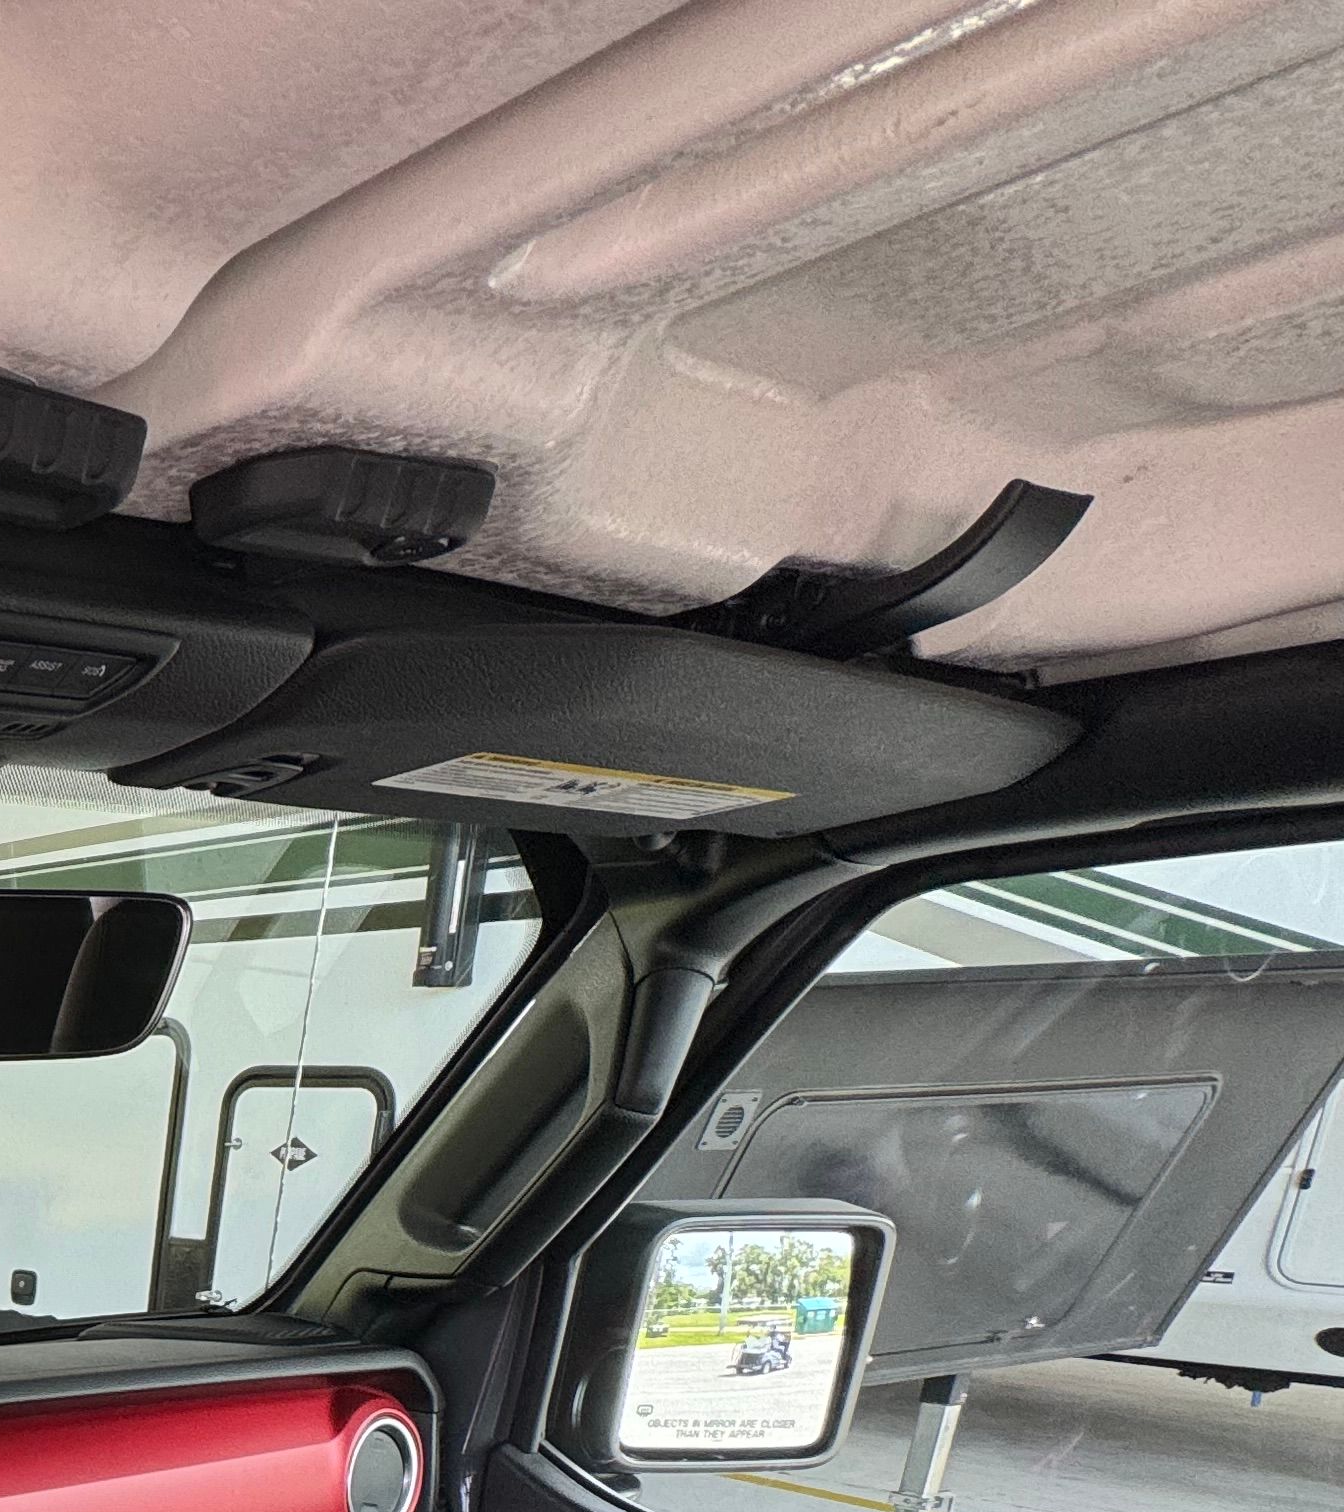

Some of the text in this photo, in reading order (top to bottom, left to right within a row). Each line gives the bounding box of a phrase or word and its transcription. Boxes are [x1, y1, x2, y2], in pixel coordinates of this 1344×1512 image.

[647, 1419, 689, 1429] OBJECTS
[703, 1419, 736, 1429] MIRROR
[739, 1419, 758, 1428] ARE
[760, 1419, 796, 1429] CLOSER
[676, 1429, 766, 1439] THAN THEY APPEAR
